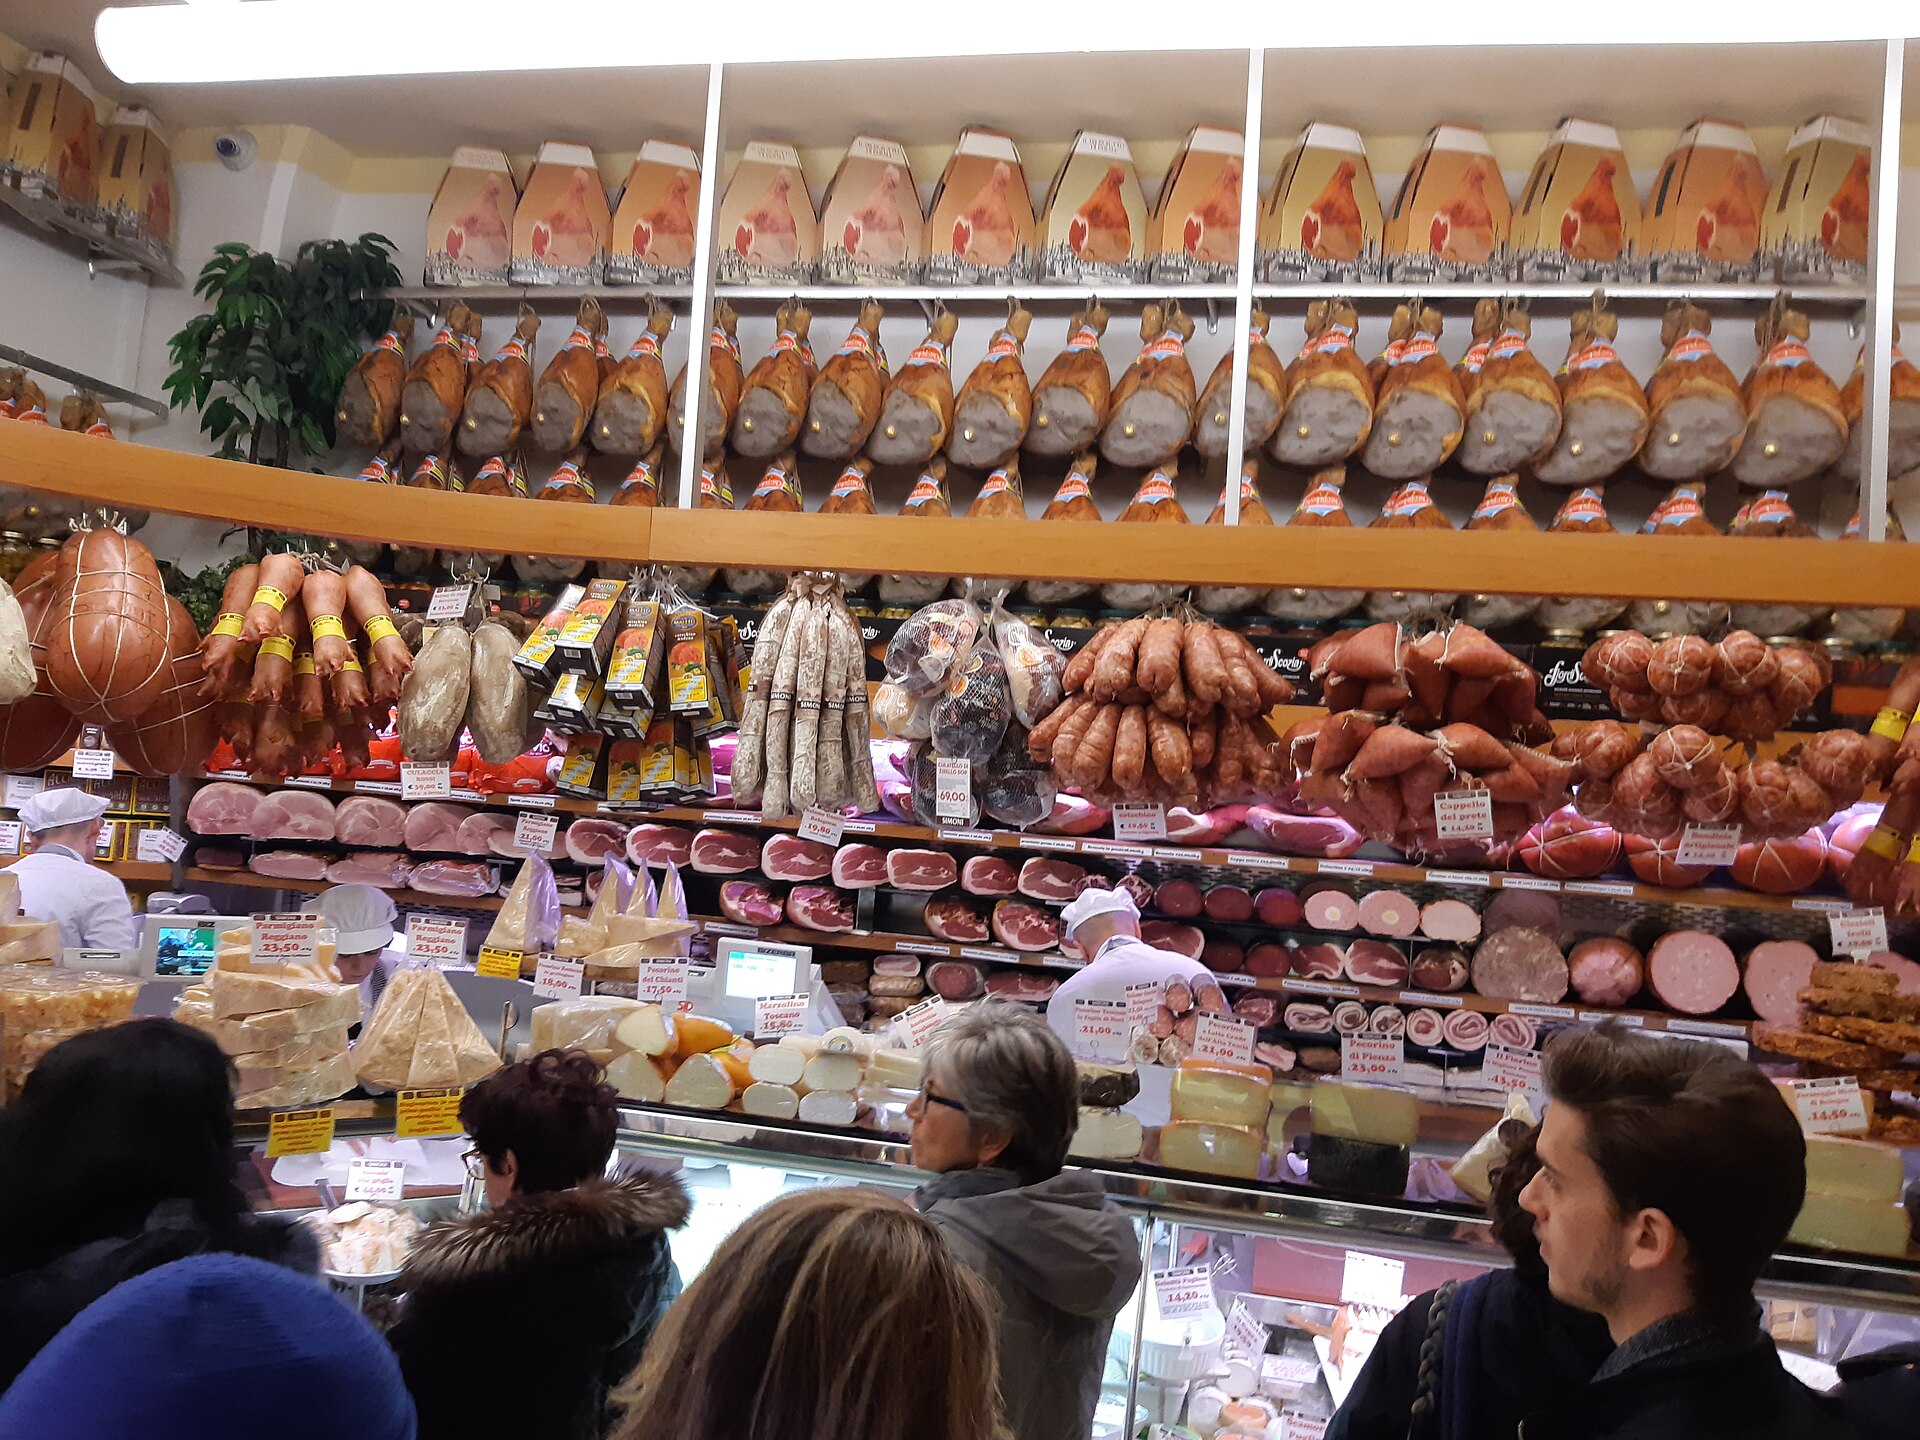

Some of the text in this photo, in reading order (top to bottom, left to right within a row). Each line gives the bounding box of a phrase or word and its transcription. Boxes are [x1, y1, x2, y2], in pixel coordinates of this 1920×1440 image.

[800, 701, 820, 709] SIMON
[940, 790, 966, 802] 69,00
[1440, 800, 1486, 810] Cappello
[942, 816, 964, 826] SIMONI
[1440, 812, 1487, 821] del prete
[256, 922, 314, 930] Parmigiano
[411, 924, 462, 935] Parmigiano
[260, 932, 308, 942] Reggiano
[415, 934, 456, 944] Reggiano
[262, 943, 300, 953] 23,50
[416, 944, 448, 954] 23,50
[646, 966, 680, 974] Pecorino
[646, 985, 672, 994] 17,50
[759, 1000, 805, 1010] Marzolino
[763, 1011, 800, 1020] Toscano
[763, 1021, 792, 1031] 15,80
[1208, 1020, 1244, 1033] Pecorino
[1350, 1039, 1396, 1049] Pecorino
[1202, 1044, 1234, 1057] 21,00
[1348, 1052, 1396, 1062] di Pienza
